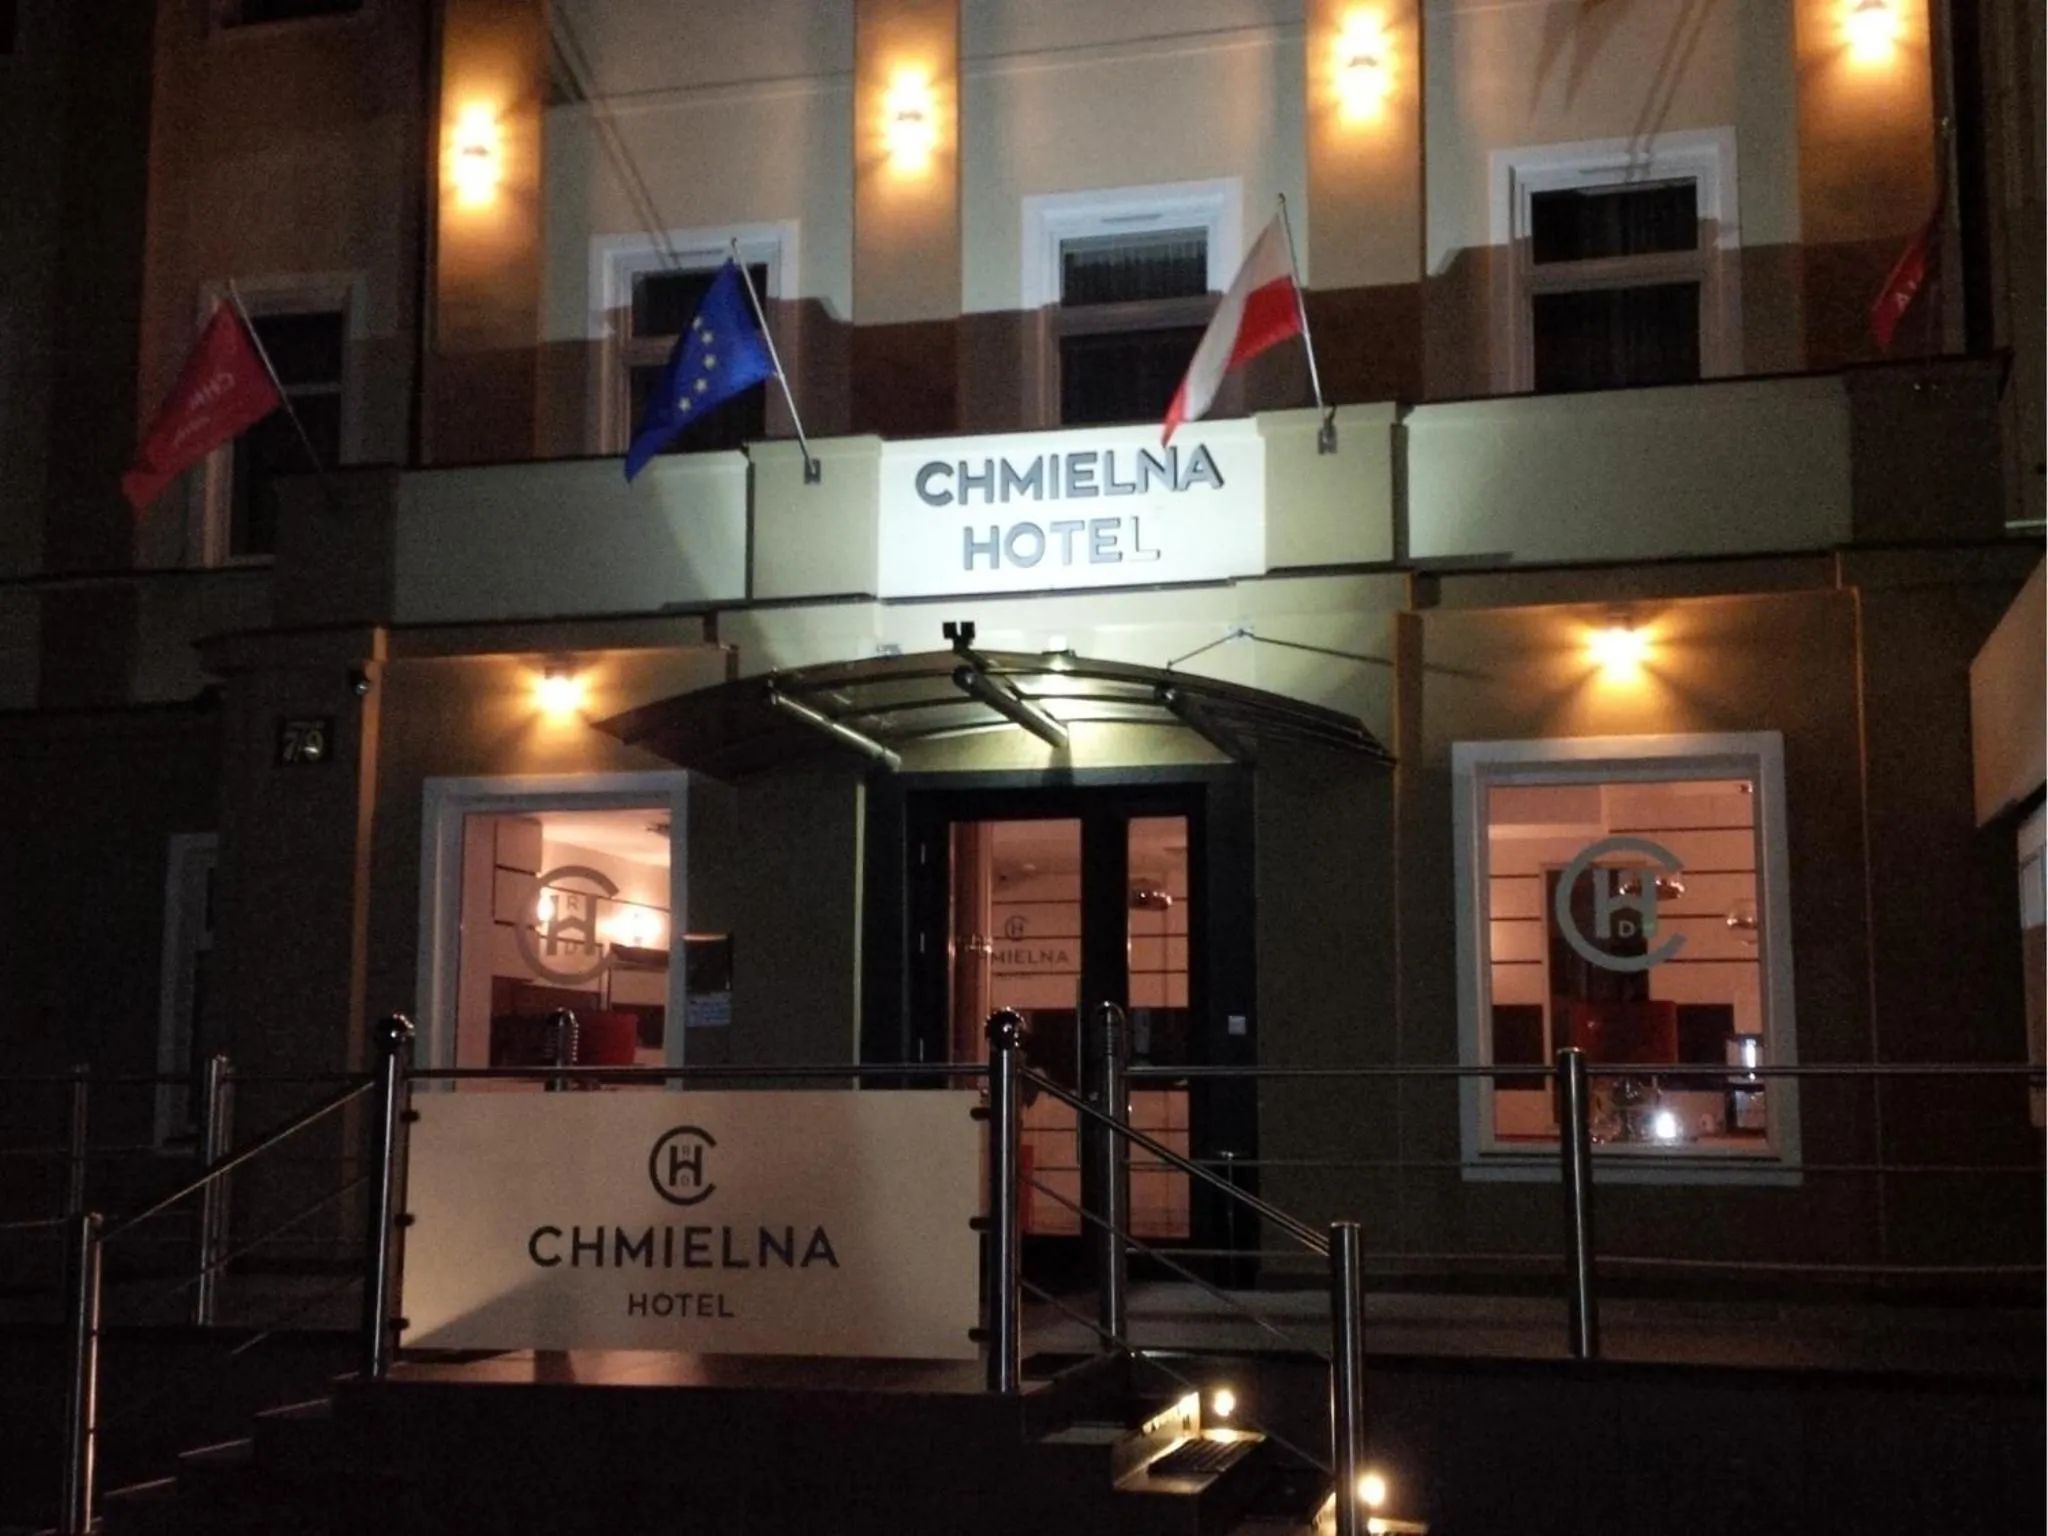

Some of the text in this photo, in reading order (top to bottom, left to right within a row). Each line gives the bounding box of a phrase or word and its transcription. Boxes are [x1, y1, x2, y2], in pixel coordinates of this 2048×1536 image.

[915, 444, 1224, 507] CHMIELNA
[963, 516, 1160, 570] HOTEL
[528, 1225, 839, 1268] CHMIELNA
[627, 1292, 735, 1318] HOTEL
